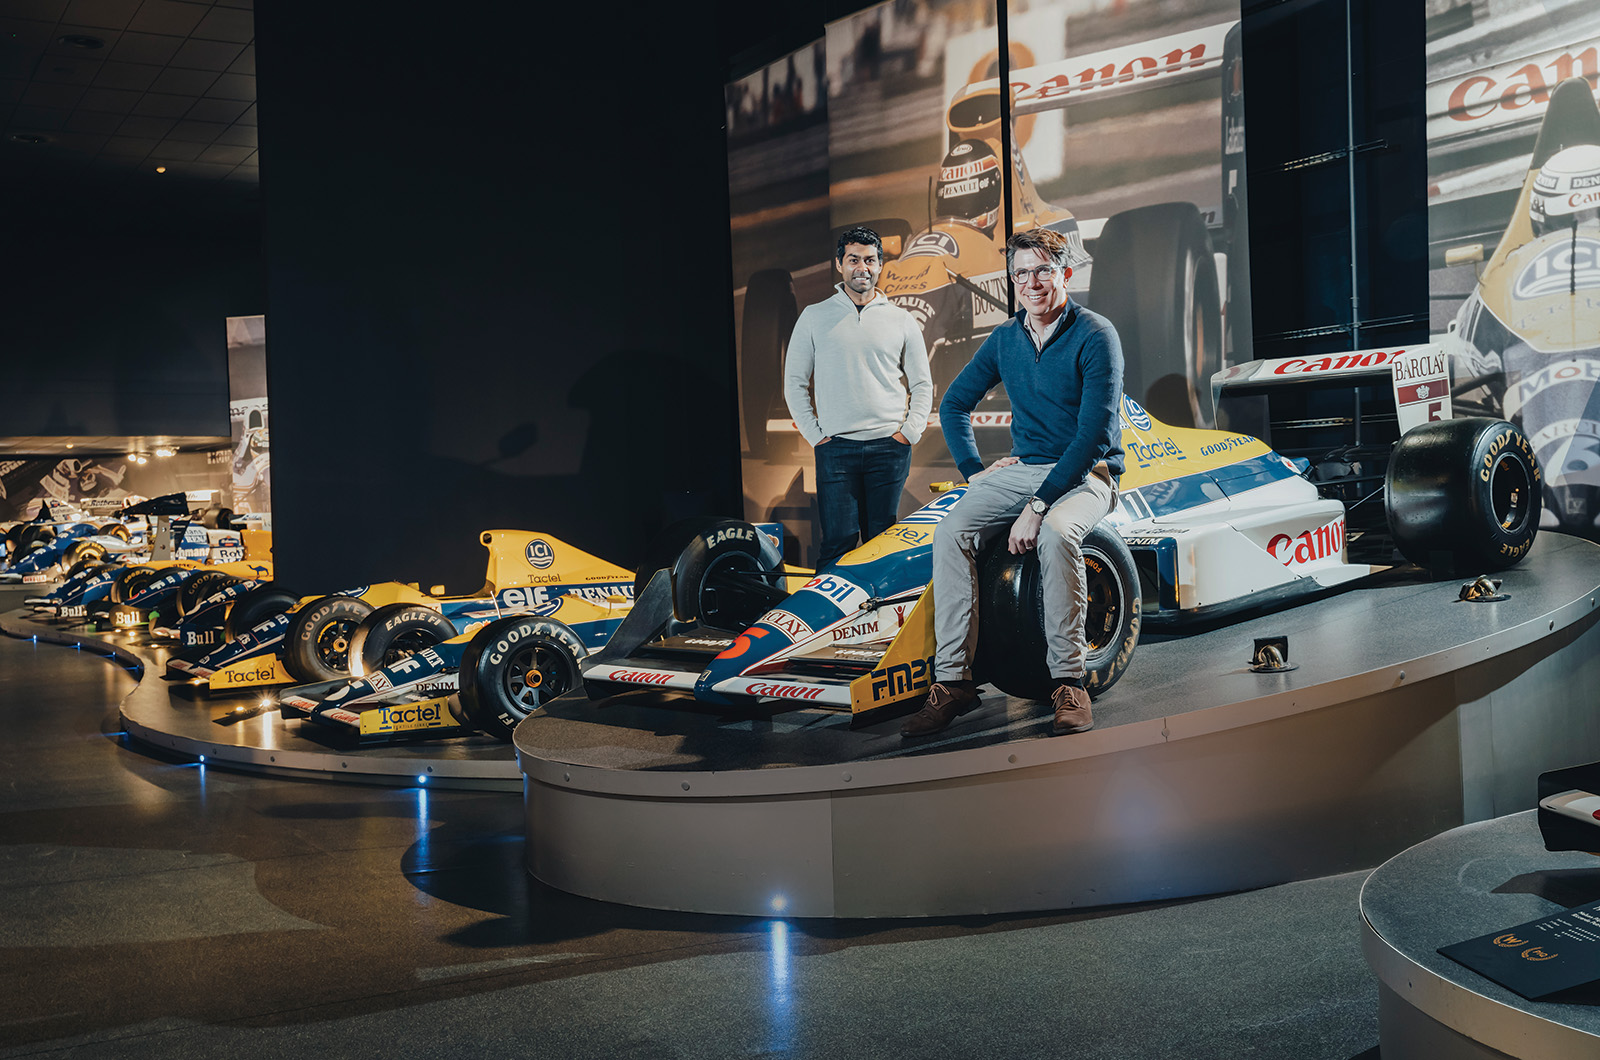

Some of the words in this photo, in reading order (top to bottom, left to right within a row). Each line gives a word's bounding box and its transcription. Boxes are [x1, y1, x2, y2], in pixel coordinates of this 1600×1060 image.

[886, 265, 931, 282] World
[884, 282, 928, 294] Class
[1394, 353, 1445, 381] BARCLAY
[1127, 437, 1183, 463] Tactel
[1200, 435, 1257, 457] GOODYEAR
[706, 527, 755, 549] EAGLE
[529, 544, 548, 557] ICI
[1500, 538, 1530, 557] EAGLE
[527, 573, 562, 584] Tactel
[502, 586, 552, 610] elf
[61, 606, 84, 617] Bull
[115, 611, 141, 625] Bull
[385, 612, 427, 632] EAGLE
[832, 620, 879, 641] DENIM
[186, 630, 215, 646] Bull
[225, 667, 276, 683] Tactel
[608, 669, 676, 685] Canon
[416, 682, 455, 691] DENIM
[745, 682, 826, 700] Canon
[378, 703, 442, 724] Tactel
